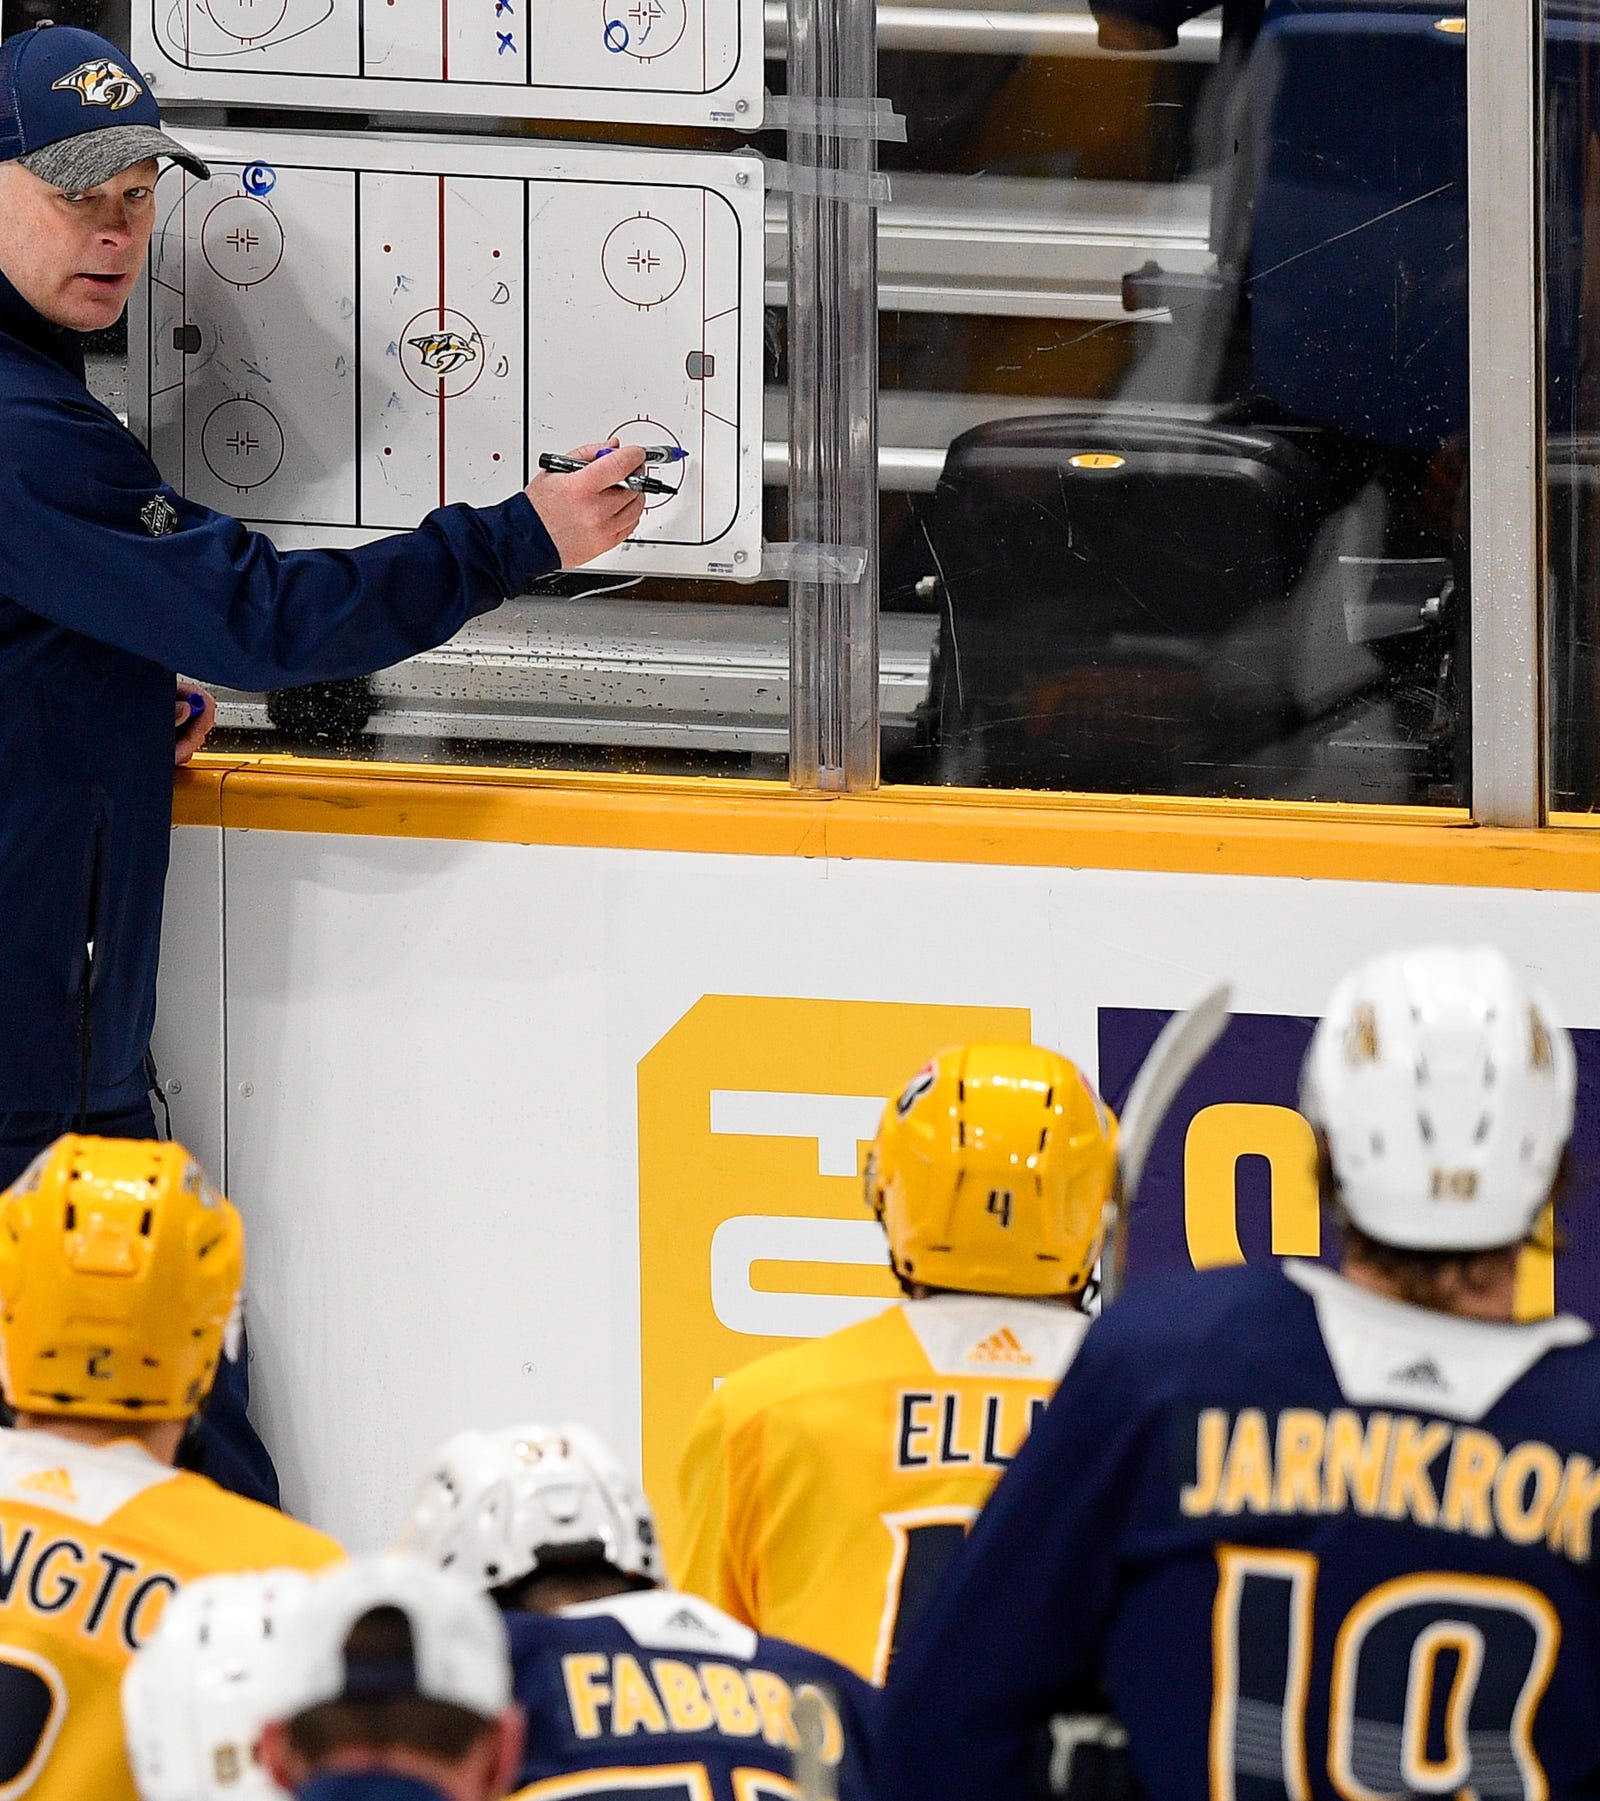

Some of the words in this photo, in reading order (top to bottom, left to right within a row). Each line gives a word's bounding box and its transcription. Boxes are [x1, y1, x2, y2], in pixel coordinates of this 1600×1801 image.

[987, 1190, 1012, 1228] 4
[1180, 1407, 1600, 1563] JARNKROK
[1208, 1543, 1562, 1801] 19
